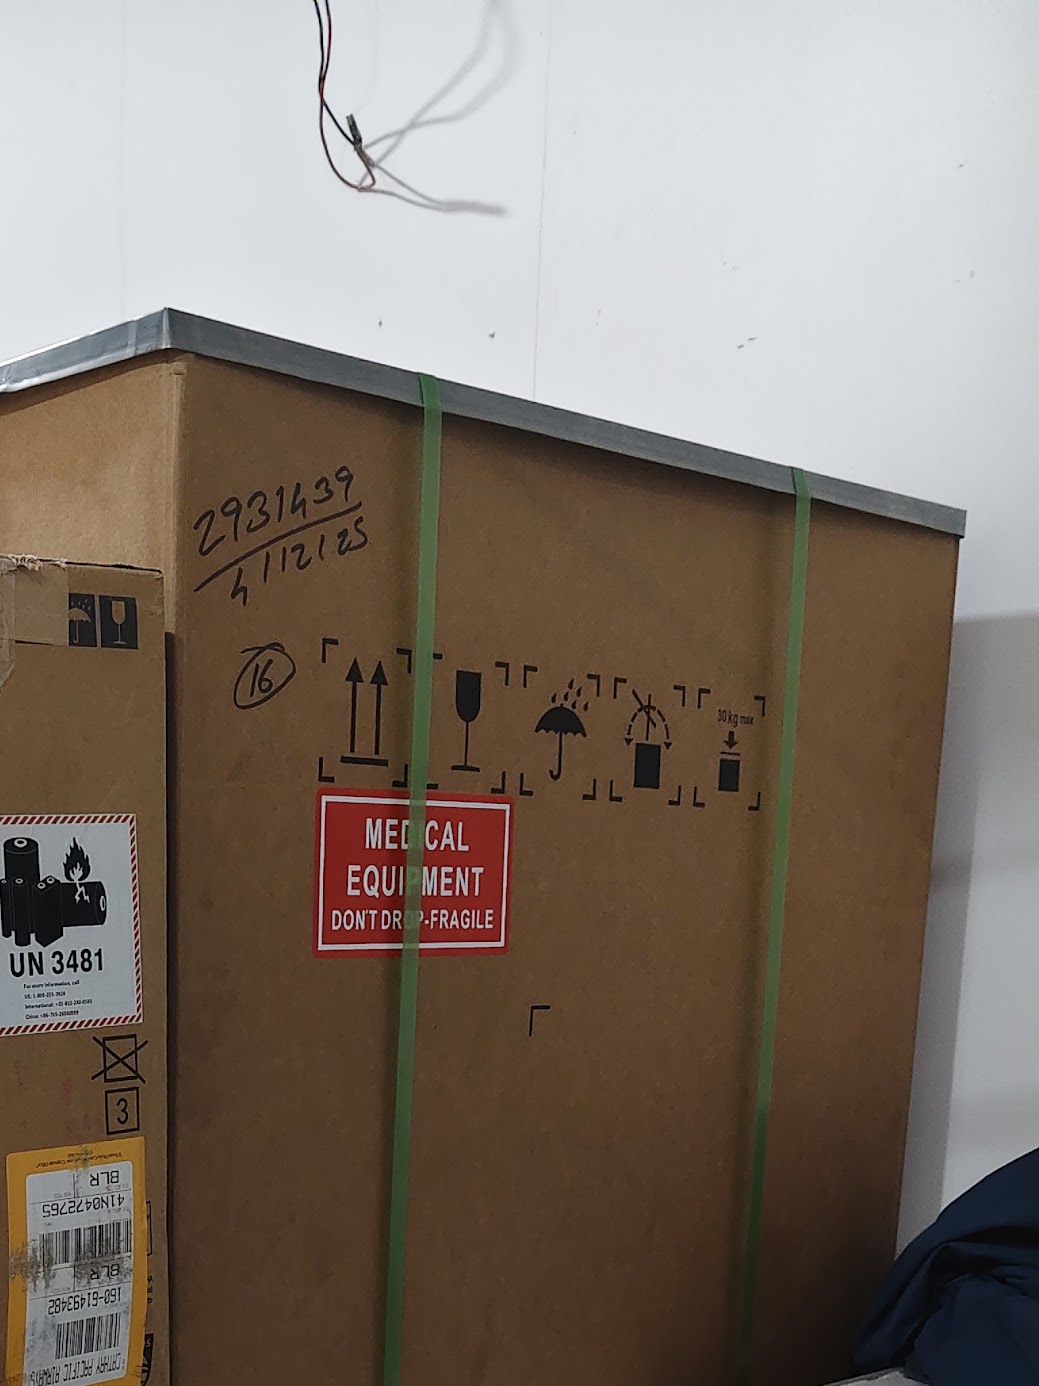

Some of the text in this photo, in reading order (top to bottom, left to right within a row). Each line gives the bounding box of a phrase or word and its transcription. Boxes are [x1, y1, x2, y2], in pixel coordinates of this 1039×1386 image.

[193, 465, 354, 557] 2931439
[249, 658, 274, 697] 16
[365, 817, 470, 852] MEDCAL
[347, 864, 485, 898] EQUIMENT
[331, 909, 378, 931] DON'T
[9, 947, 104, 978] UN 3481
[116, 1097, 129, 1125] 3
[89, 1170, 120, 1187] BLR
[42, 1194, 125, 1218] 41N0472765
[90, 1263, 120, 1281] BLR
[48, 1287, 122, 1315] 160-61493482
[63, 1358, 95, 1382] PACIFIC
[95, 1352, 122, 1375] CATHAY
